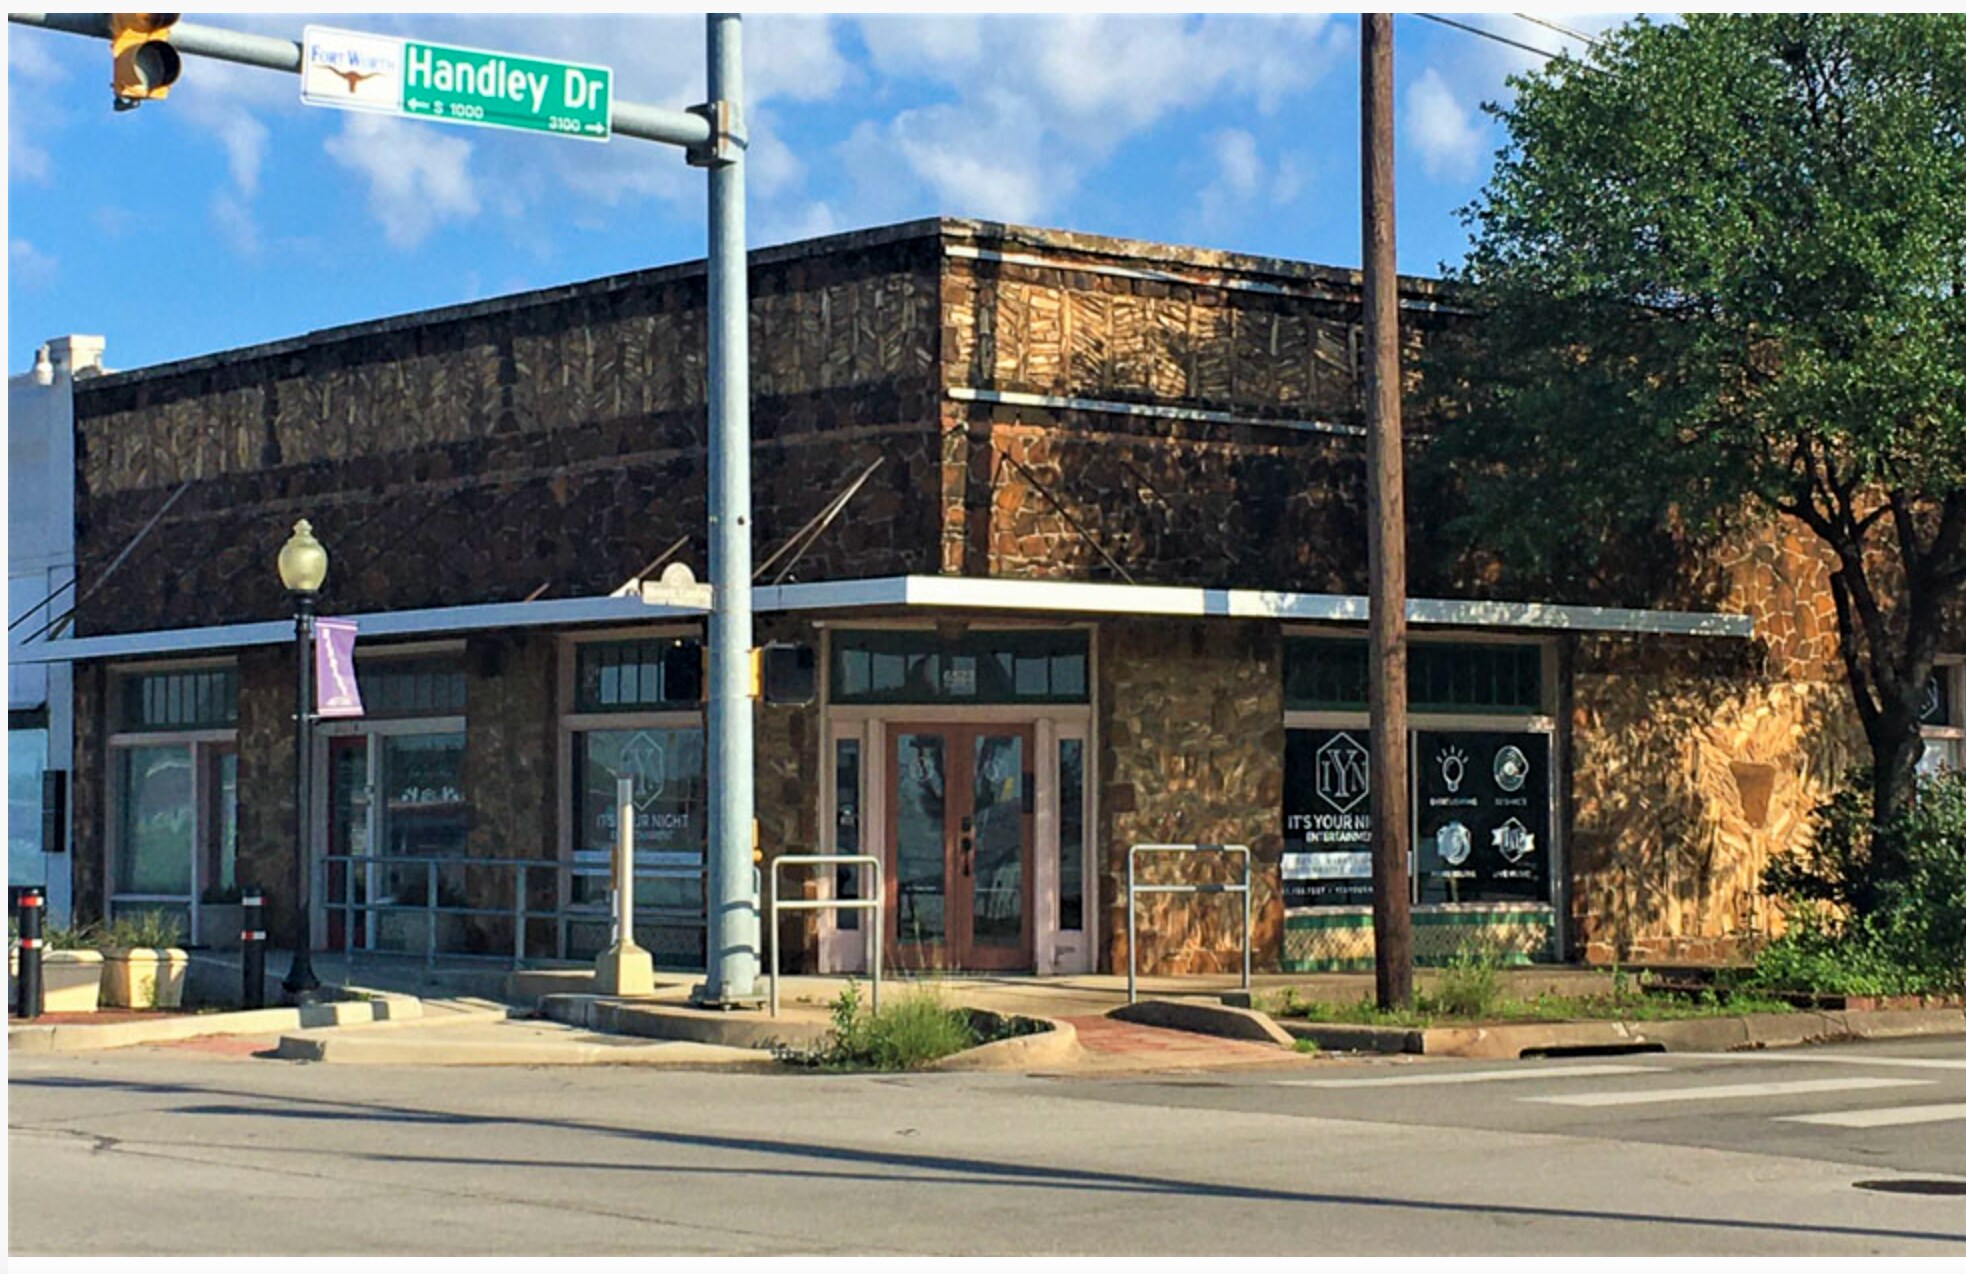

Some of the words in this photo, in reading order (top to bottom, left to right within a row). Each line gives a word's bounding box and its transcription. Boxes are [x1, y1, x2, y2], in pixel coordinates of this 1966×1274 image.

[407, 46, 549, 114] Handley
[563, 68, 605, 111] Dr
[433, 102, 444, 115] S
[450, 102, 484, 119] 1000
[549, 115, 580, 132] 3100
[1313, 814, 1352, 830] YOUR
